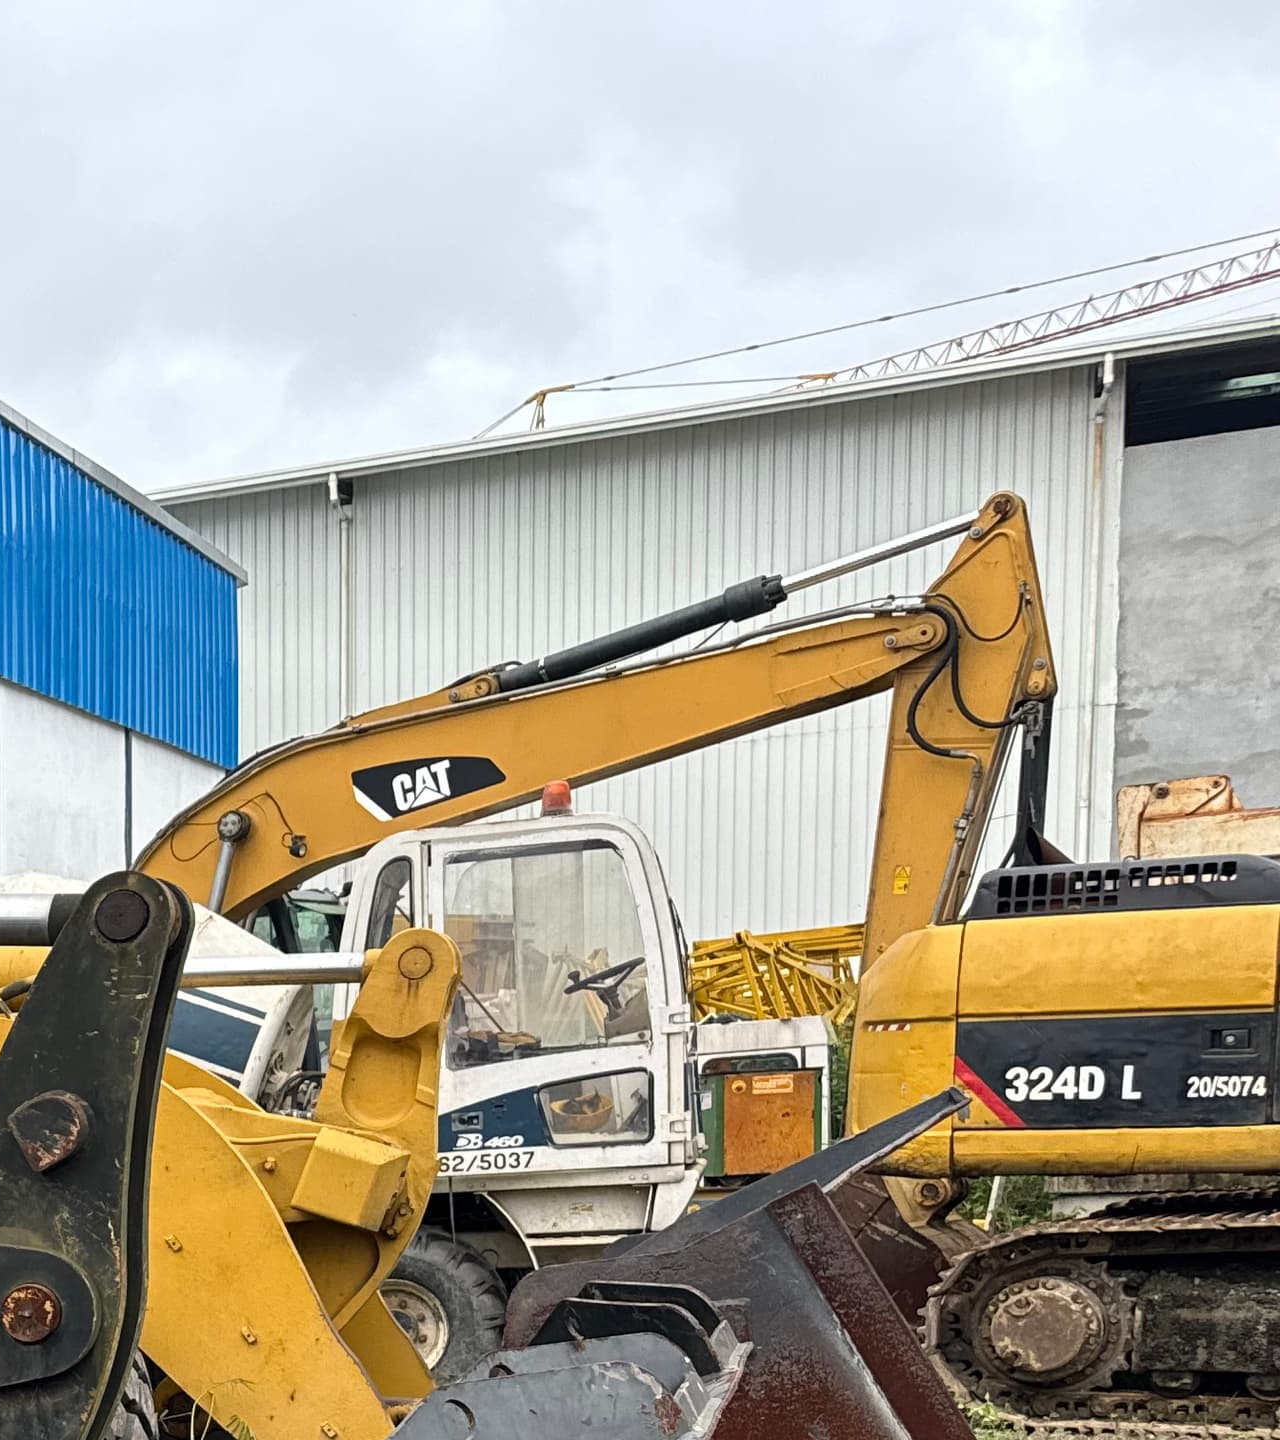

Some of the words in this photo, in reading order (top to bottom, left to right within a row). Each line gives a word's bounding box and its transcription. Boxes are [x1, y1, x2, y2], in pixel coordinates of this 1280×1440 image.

[391, 758, 453, 812] CAT
[1004, 1064, 1105, 1102] 324D
[1121, 1064, 1143, 1101] L
[1186, 1074, 1267, 1100] 20/5074
[484, 1134, 525, 1149] 460
